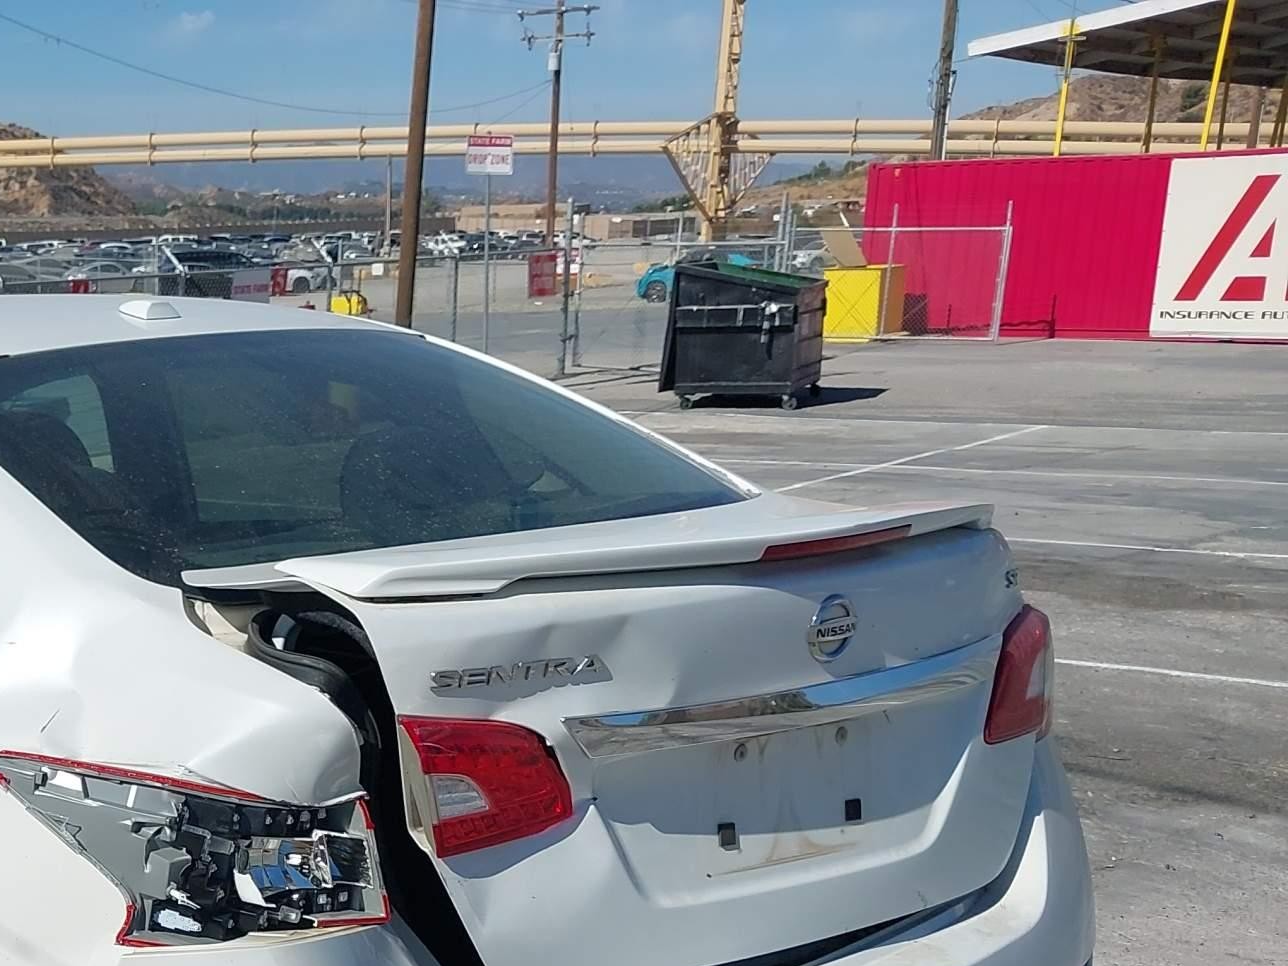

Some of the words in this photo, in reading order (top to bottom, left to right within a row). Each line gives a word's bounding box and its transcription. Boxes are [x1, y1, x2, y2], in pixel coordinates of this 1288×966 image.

[468, 153, 488, 165] DROP
[490, 153, 511, 165] ZONE
[1159, 309, 1256, 321] INSURANCE
[816, 621, 857, 640] NISSAN
[429, 653, 612, 691] SENTRA
